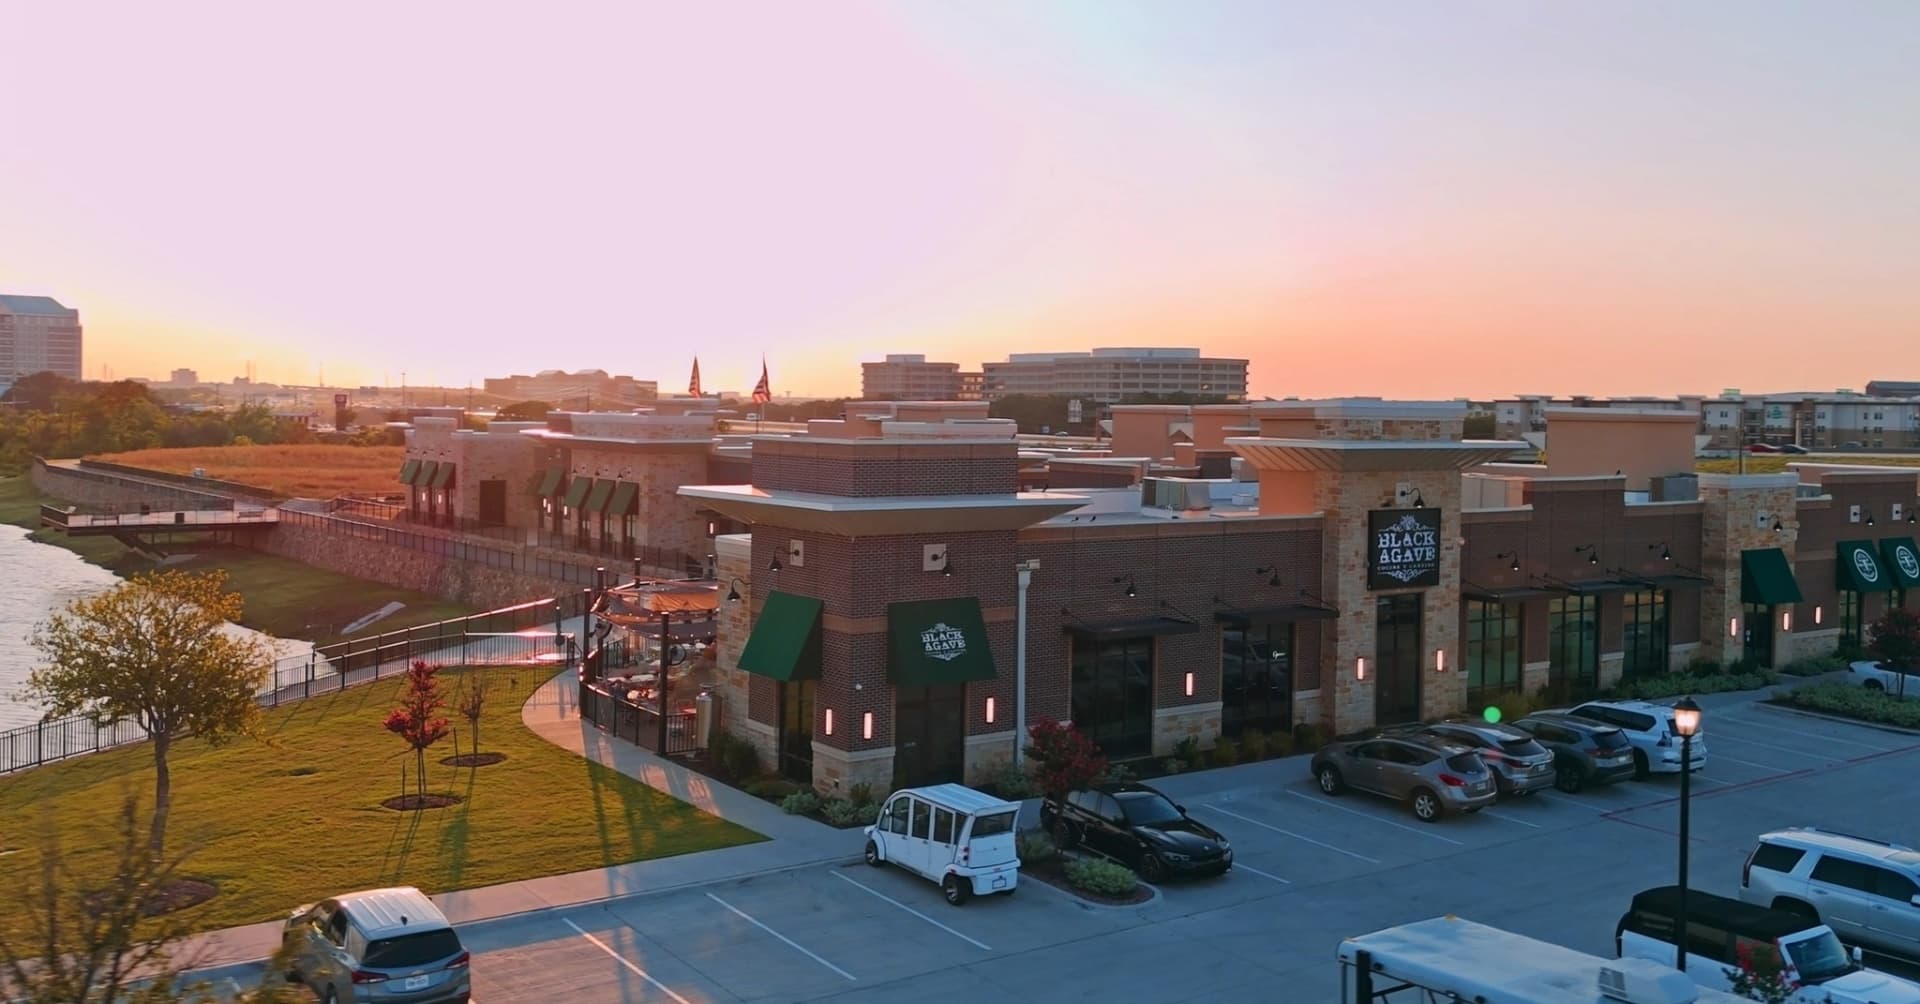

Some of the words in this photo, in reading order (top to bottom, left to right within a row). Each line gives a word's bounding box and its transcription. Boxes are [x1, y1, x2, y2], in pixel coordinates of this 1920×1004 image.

[1378, 531, 1436, 548] BLACK
[1379, 546, 1435, 564] AGAVE
[921, 631, 964, 643] BLACK
[925, 640, 966, 652] AGAVE
